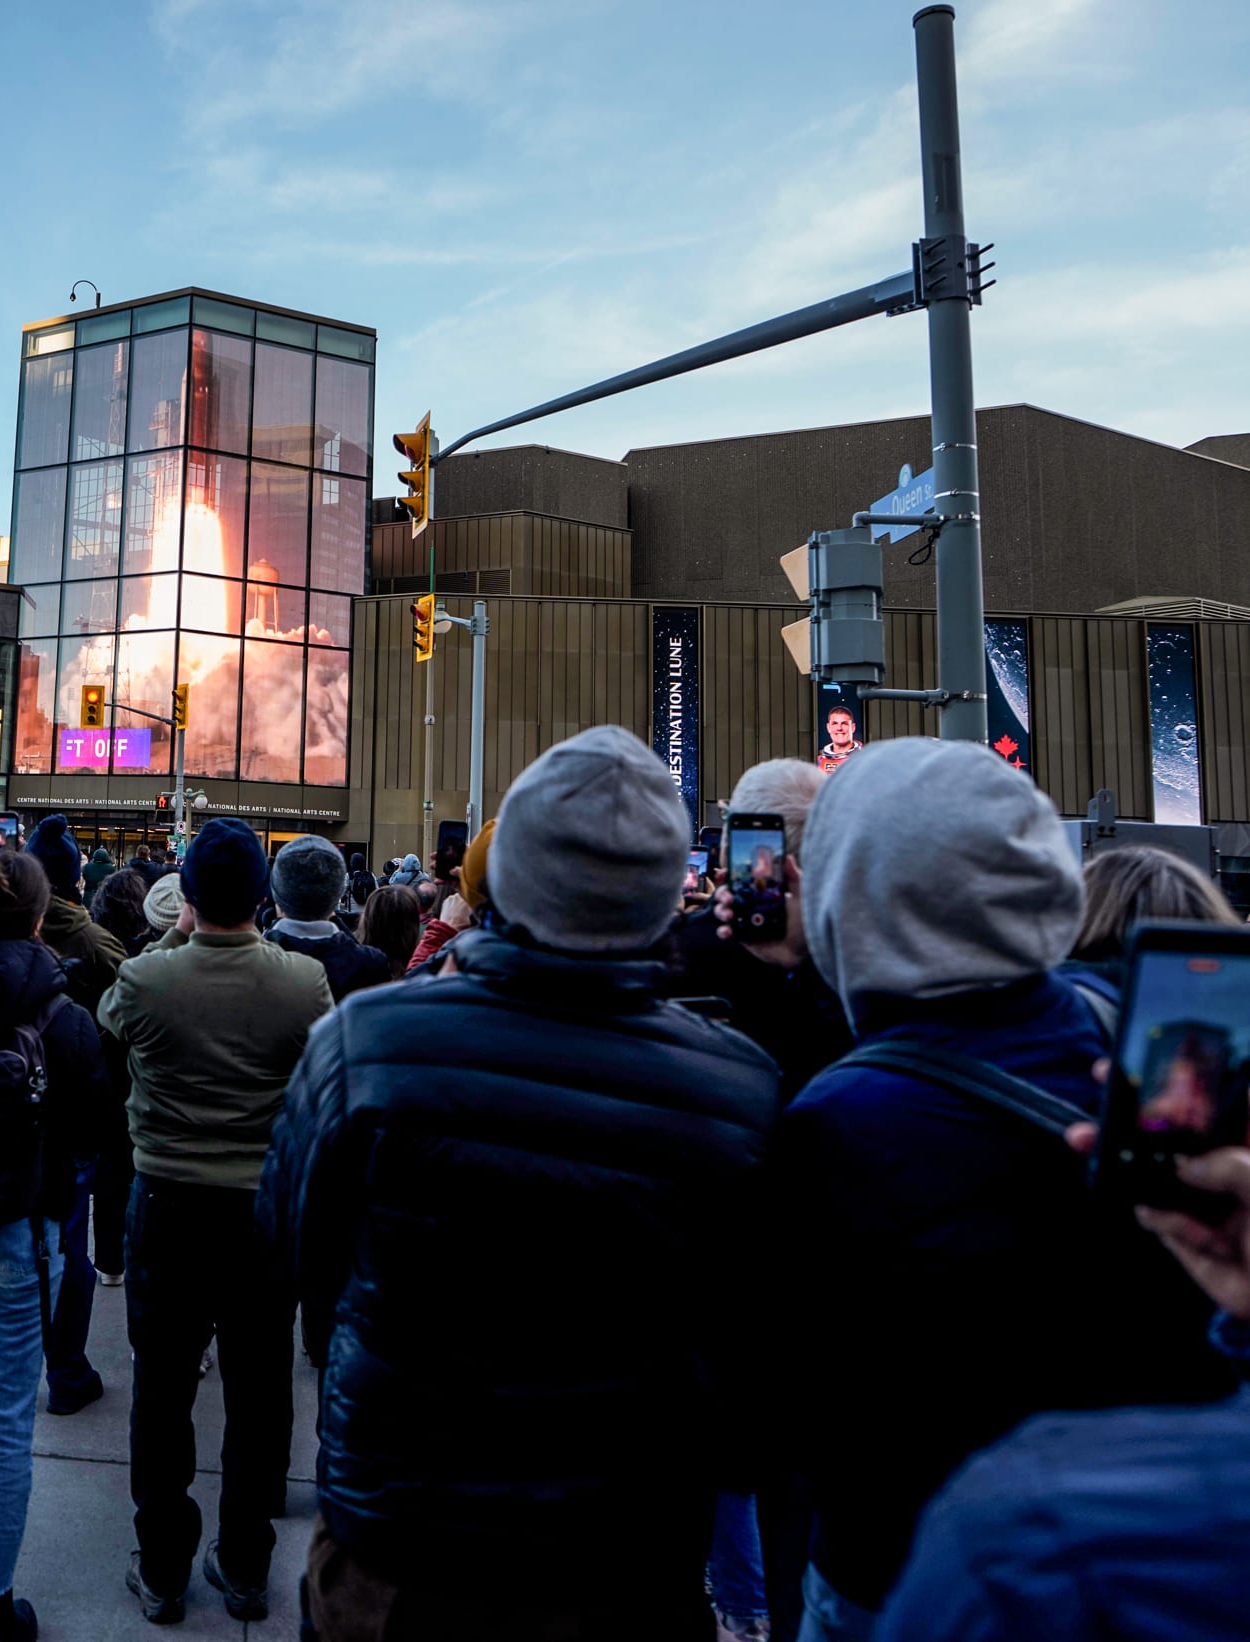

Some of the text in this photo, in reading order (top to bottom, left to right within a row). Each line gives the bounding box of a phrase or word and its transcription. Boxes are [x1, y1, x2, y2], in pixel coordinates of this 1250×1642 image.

[892, 486, 923, 516] Queen
[669, 637, 682, 786] DESTINATION LUNE
[94, 738, 128, 758] OFF
[207, 803, 237, 811] NATIONAL
[272, 807, 302, 815] NATIONAL
